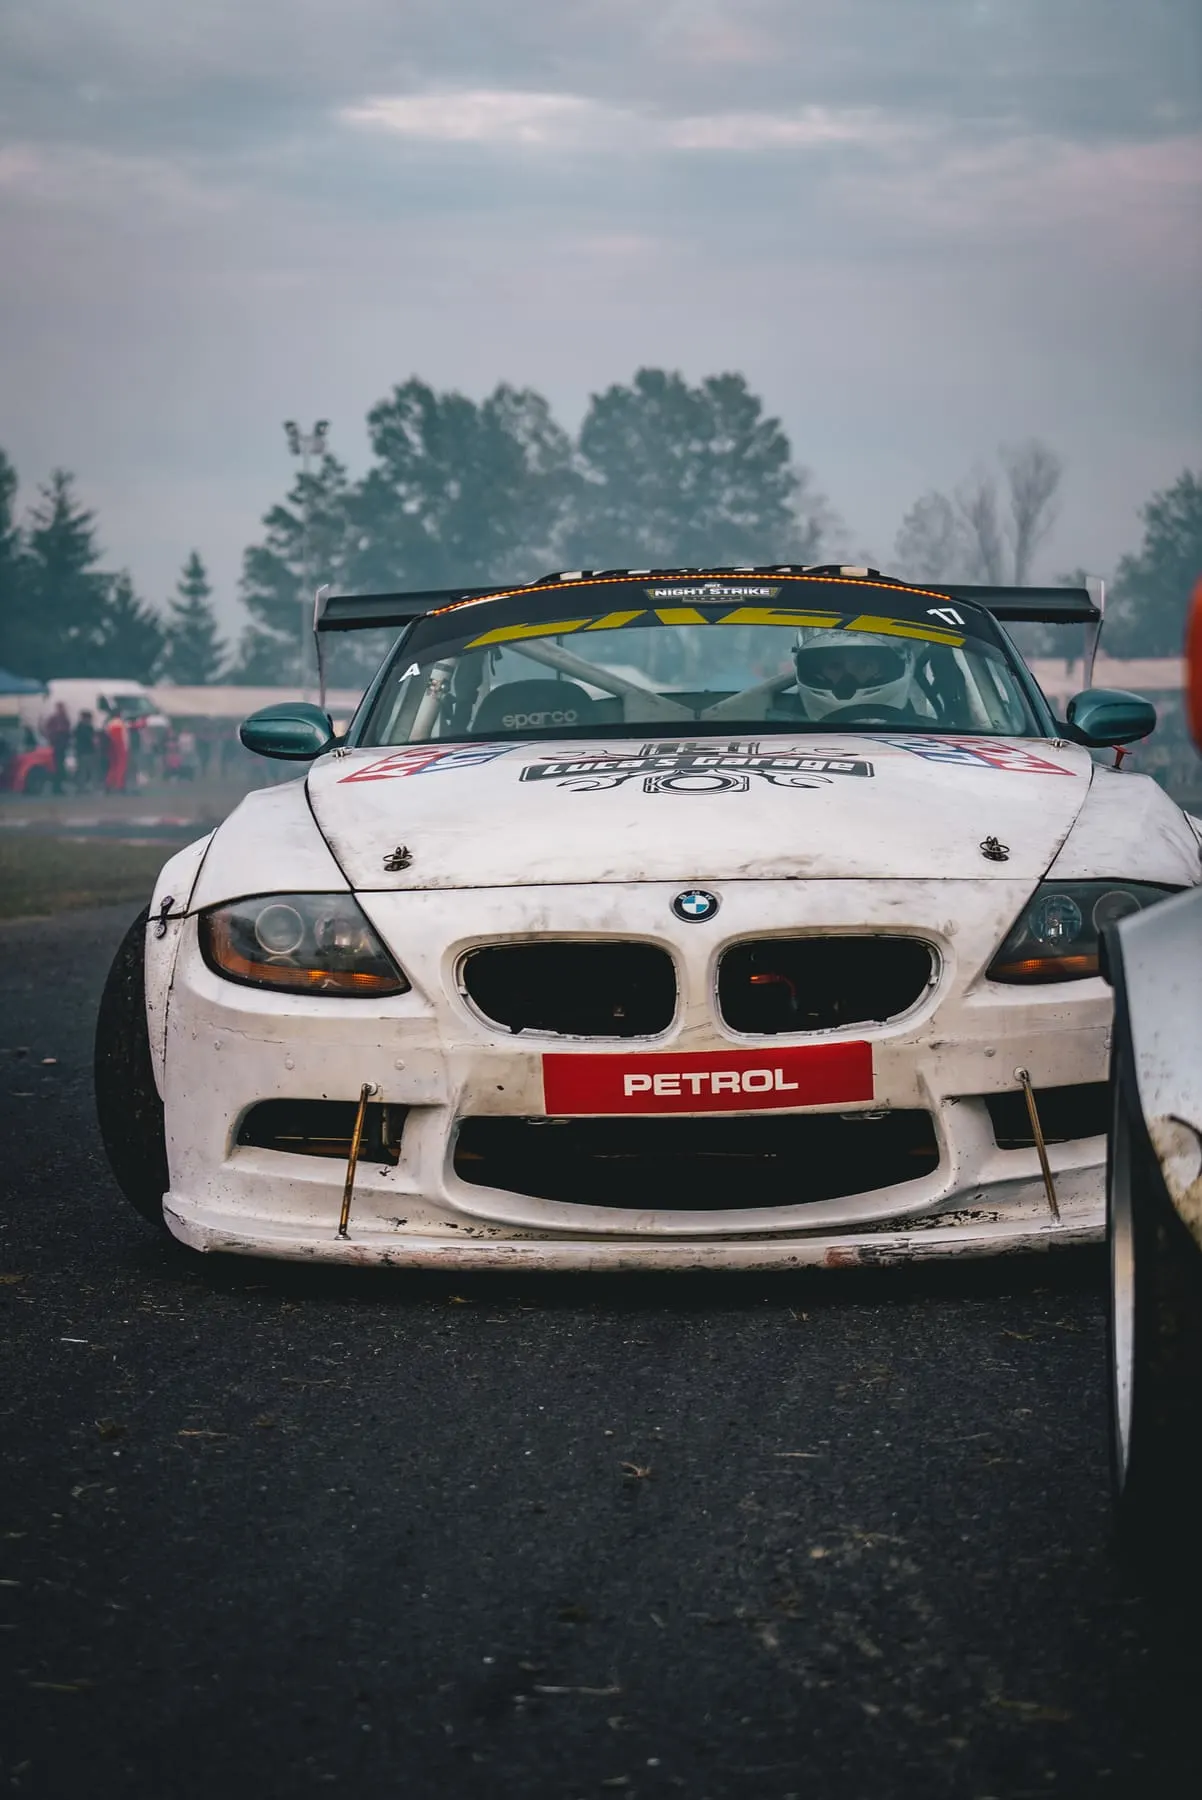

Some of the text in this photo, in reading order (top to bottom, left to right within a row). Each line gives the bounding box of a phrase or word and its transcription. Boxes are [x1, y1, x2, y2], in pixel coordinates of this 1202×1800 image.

[654, 588, 706, 597] NIGHT
[926, 608, 966, 625] 17
[502, 710, 577, 729] sparco
[541, 756, 856, 775] Luca's Garage
[623, 1068, 799, 1096] PETROL
